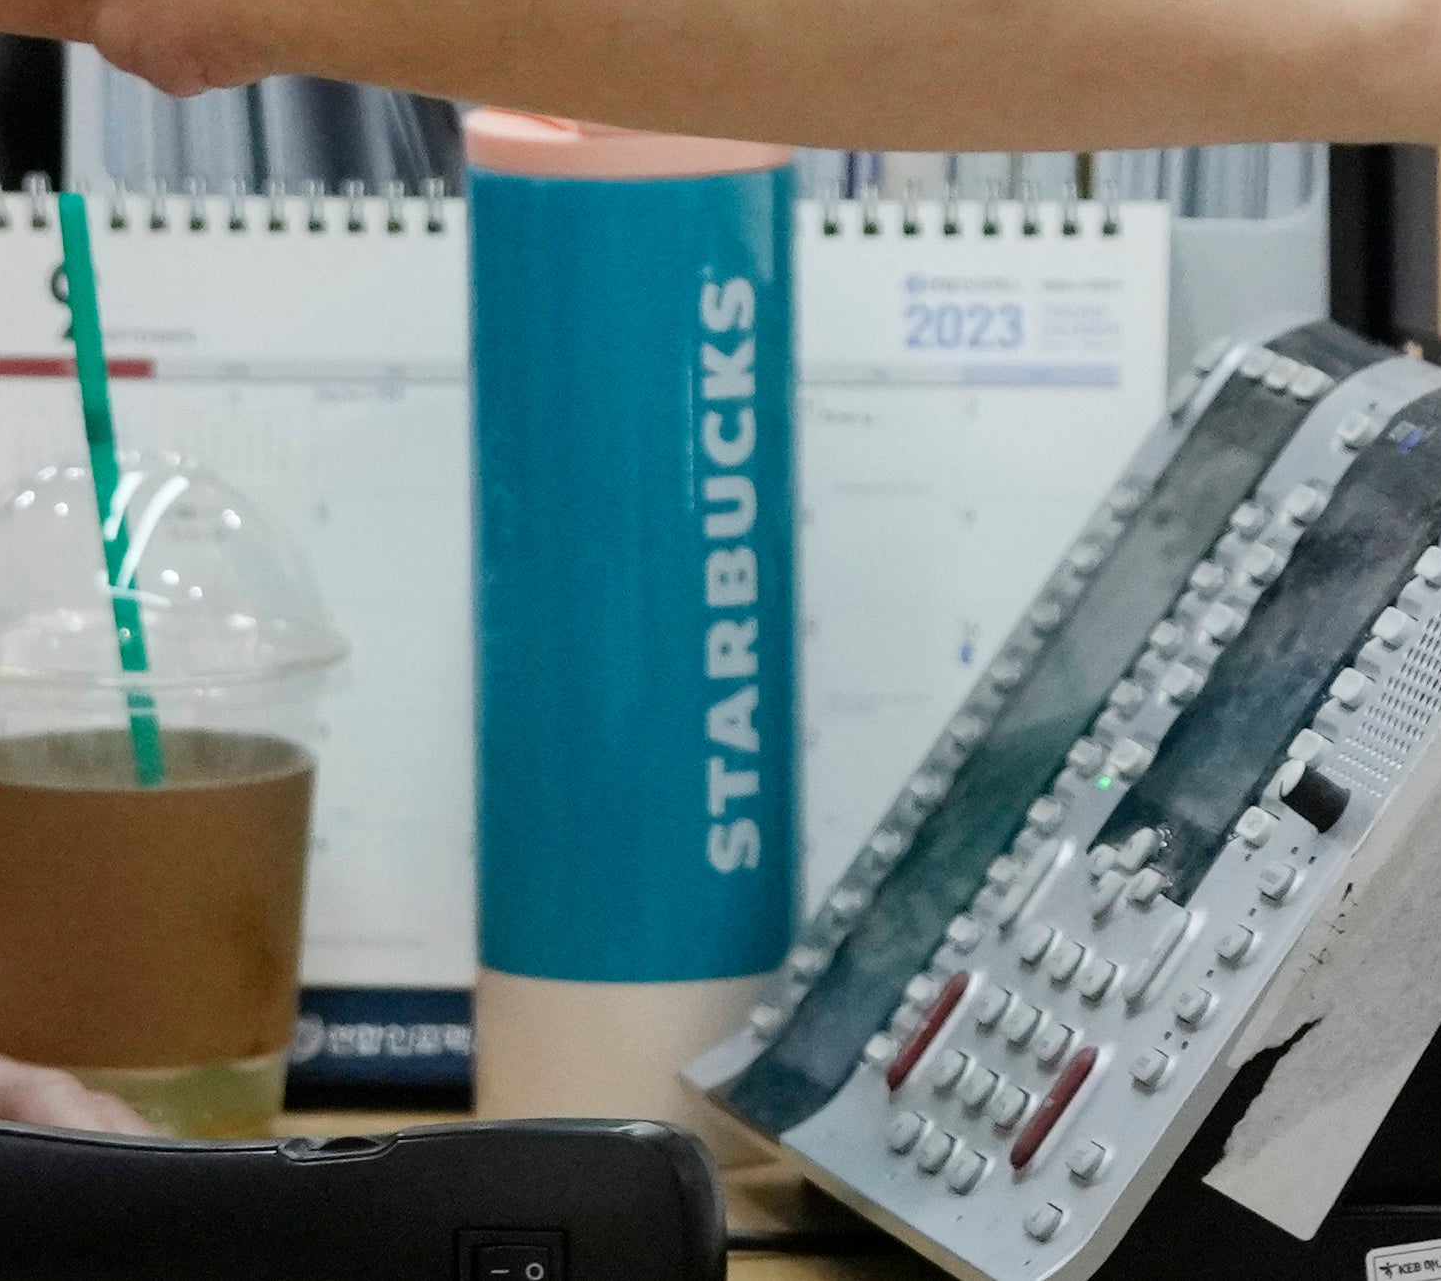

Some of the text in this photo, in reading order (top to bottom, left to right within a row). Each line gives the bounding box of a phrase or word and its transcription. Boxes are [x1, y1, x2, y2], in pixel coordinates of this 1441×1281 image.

[904, 302, 1025, 349] 2023
[698, 274, 759, 874] STARBUCKS
[1398, 1261, 1422, 1275] KEB
